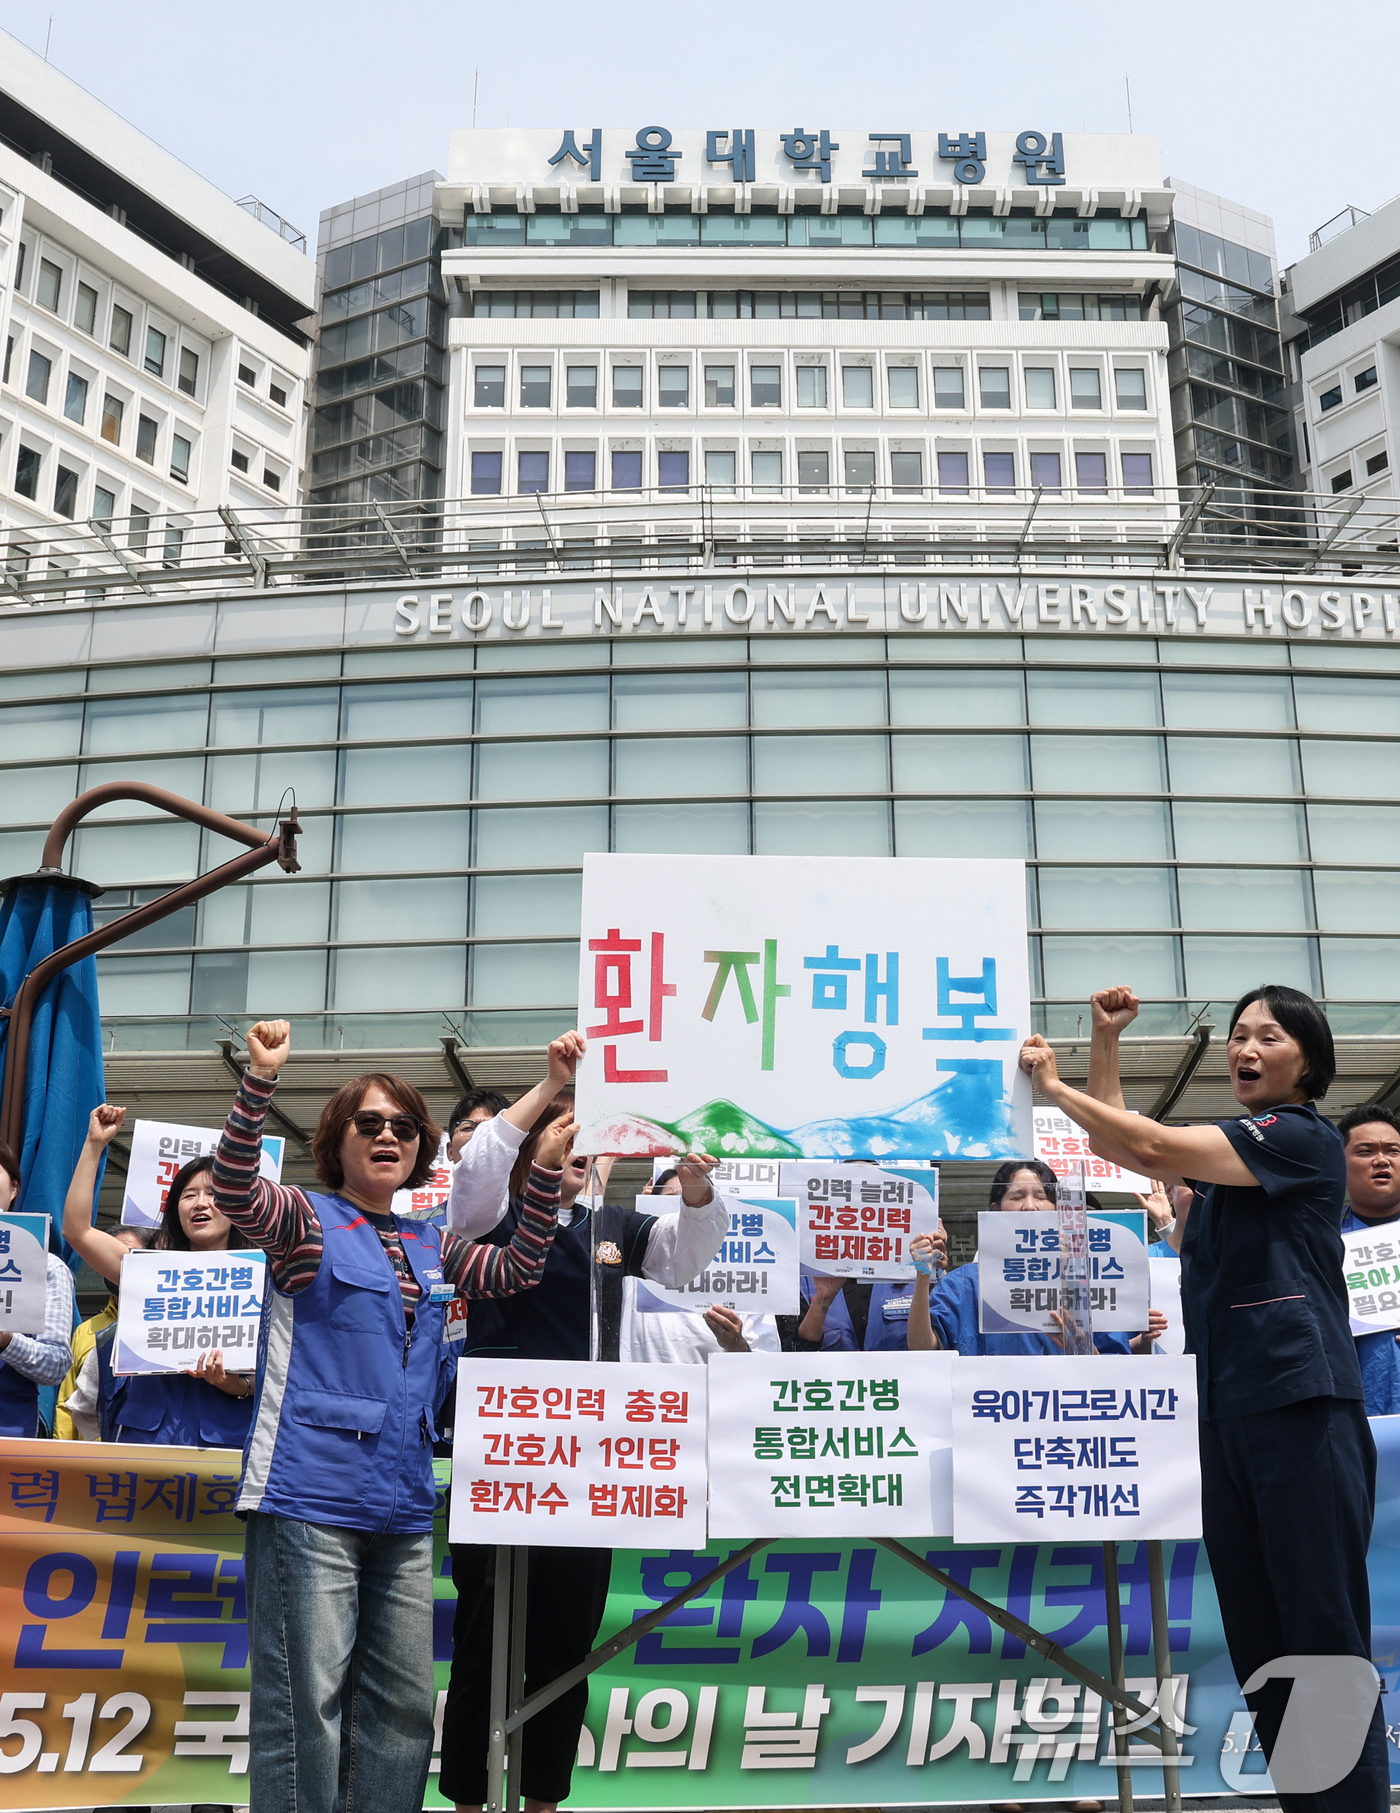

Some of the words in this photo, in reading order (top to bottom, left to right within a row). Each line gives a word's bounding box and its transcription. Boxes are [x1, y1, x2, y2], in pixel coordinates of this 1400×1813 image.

[548, 125, 1067, 186] 서울대학교병원
[395, 588, 564, 636] SEOUL
[594, 582, 869, 627] NATIONAL
[900, 582, 1215, 627] UNIVERSITY
[1243, 588, 1400, 633] HOSPI
[1034, 1117, 1072, 1134] 인력
[158, 1136, 202, 1160] 인력
[807, 1178, 852, 1203] 인력
[860, 1180, 914, 1205] 늘려!
[808, 1204, 911, 1234] 간호인력
[712, 1241, 776, 1264] 서비스
[815, 1234, 903, 1263] 법제화!
[1015, 1228, 1112, 1253] 간호병
[156, 1266, 254, 1293] 간호간병
[665, 1270, 768, 1295] 대하라!
[142, 1294, 263, 1321] 통합서비스
[146, 1324, 255, 1351] 확대하라!
[476, 1386, 606, 1422] 간호인력
[625, 1389, 689, 1424] 충원
[770, 1379, 900, 1412] 간호간병
[971, 1388, 1178, 1423] 육아기근로시간
[482, 1433, 582, 1468] 간호사
[598, 1437, 681, 1471] 1인당
[752, 1427, 919, 1460] 통합서비스
[1014, 1436, 1139, 1470] 단축제도
[470, 1479, 569, 1515] 환자수
[588, 1484, 688, 1519] 법제화
[770, 1474, 902, 1508] 전면확대
[1014, 1484, 1140, 1518] 즉각개선
[632, 1549, 882, 1665] 환자
[911, 1542, 1200, 1660] 지켜!
[740, 1683, 831, 1769] 날
